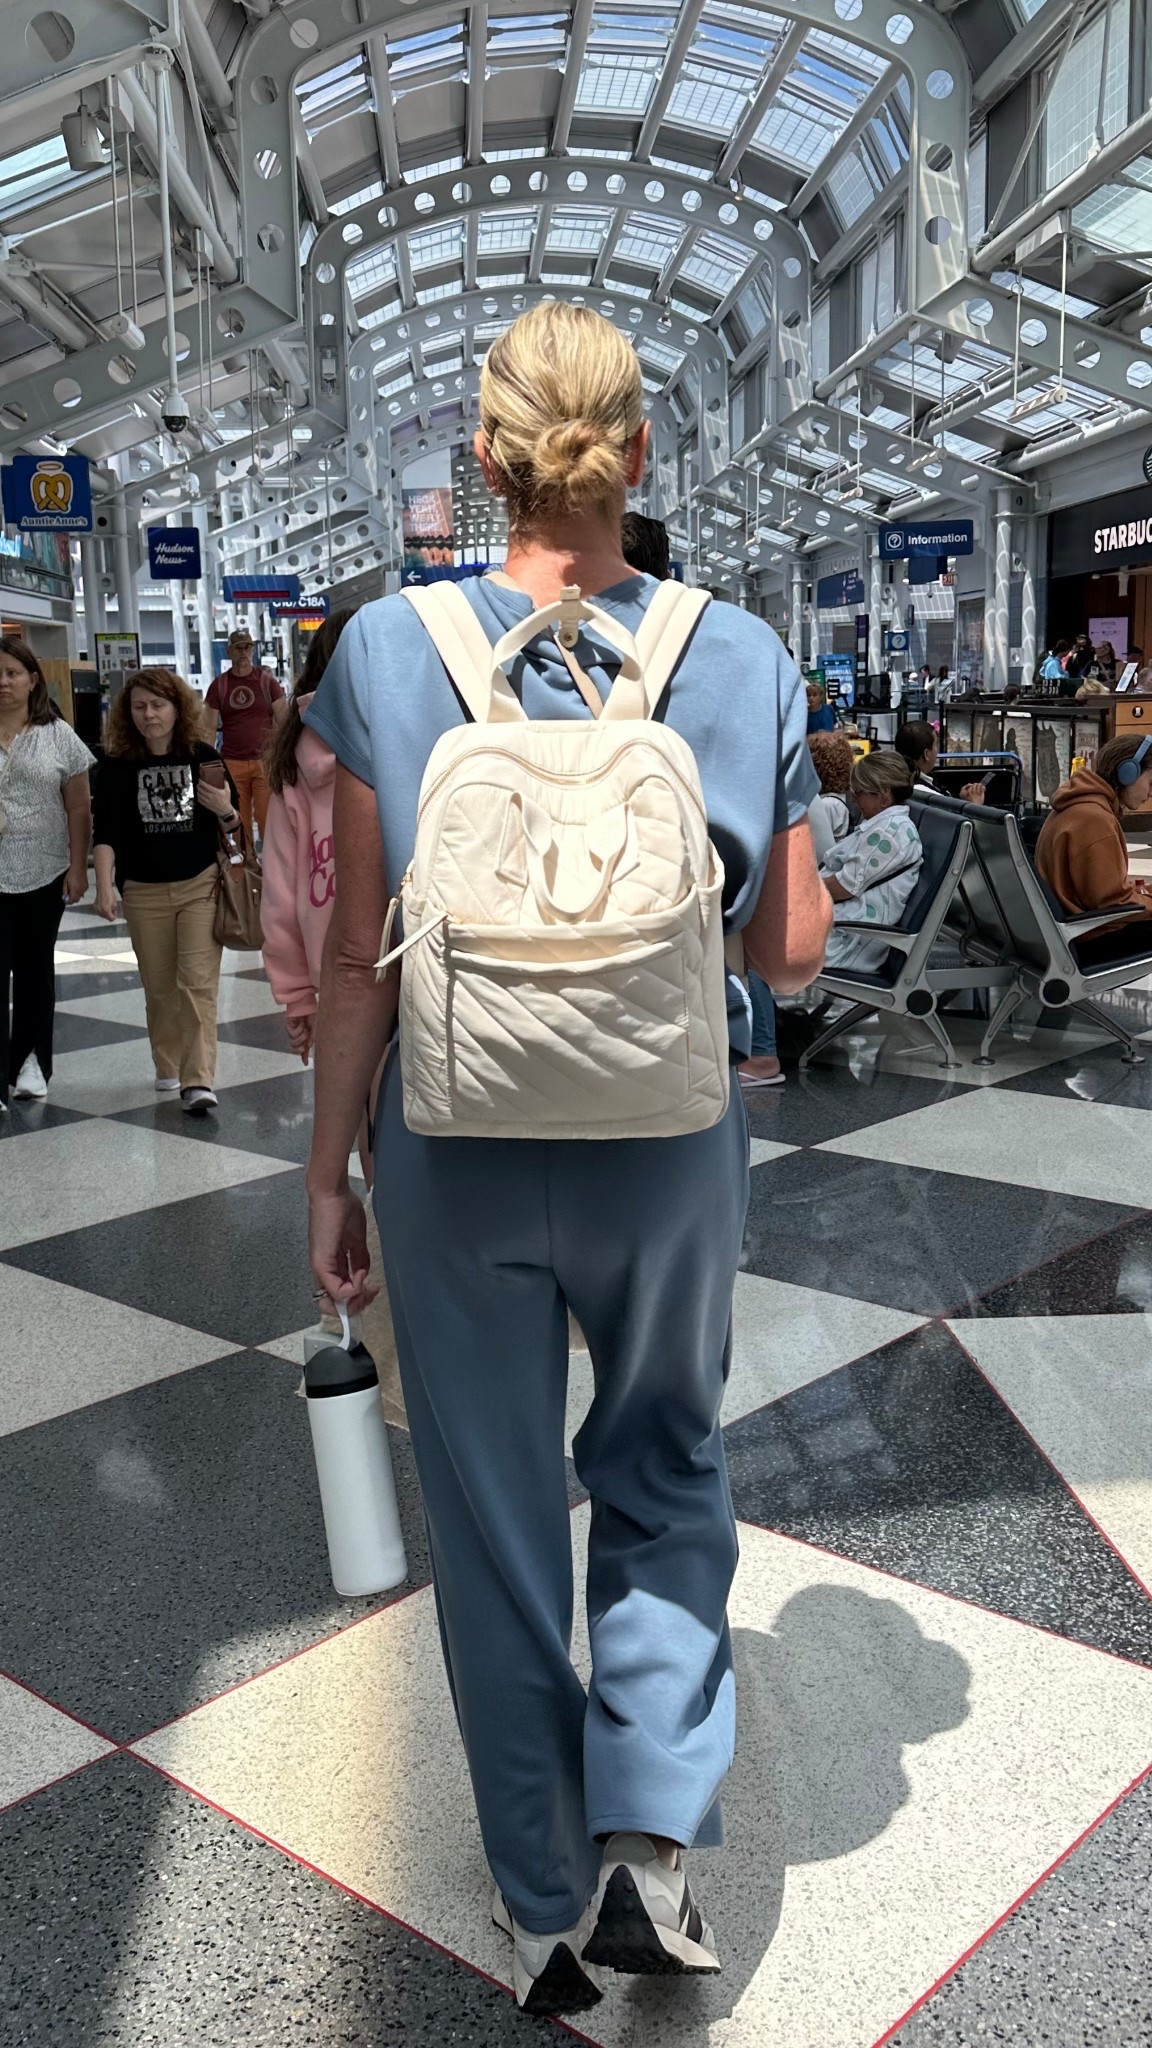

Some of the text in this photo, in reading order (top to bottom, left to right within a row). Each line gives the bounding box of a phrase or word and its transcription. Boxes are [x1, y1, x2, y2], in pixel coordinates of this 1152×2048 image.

[21, 516, 88, 526] Auntie Anne's
[908, 533, 968, 545] Information
[154, 543, 194, 553] Hudson
[155, 554, 187, 564] News
[298, 596, 325, 607] C18A
